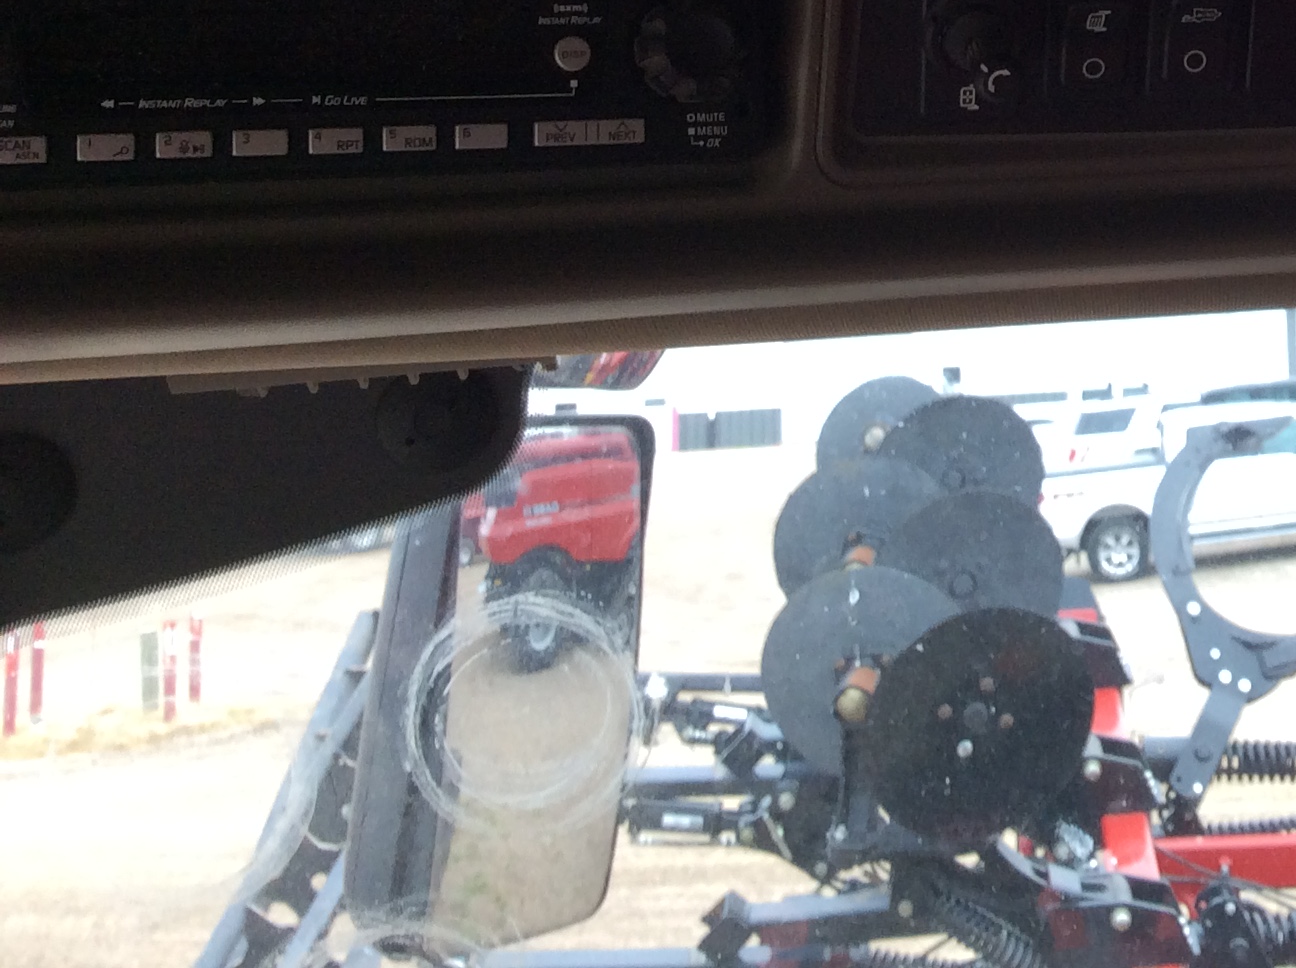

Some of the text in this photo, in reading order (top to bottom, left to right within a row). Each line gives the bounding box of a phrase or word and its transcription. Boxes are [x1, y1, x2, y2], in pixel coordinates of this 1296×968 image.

[696, 112, 726, 122] MUTE
[696, 125, 728, 136] MENU
[163, 134, 173, 146] 2
[242, 133, 251, 144] 3
[545, 132, 577, 143] PREV
[608, 131, 637, 142] NEXT
[336, 139, 361, 151] RPT
[706, 137, 722, 148] OK
